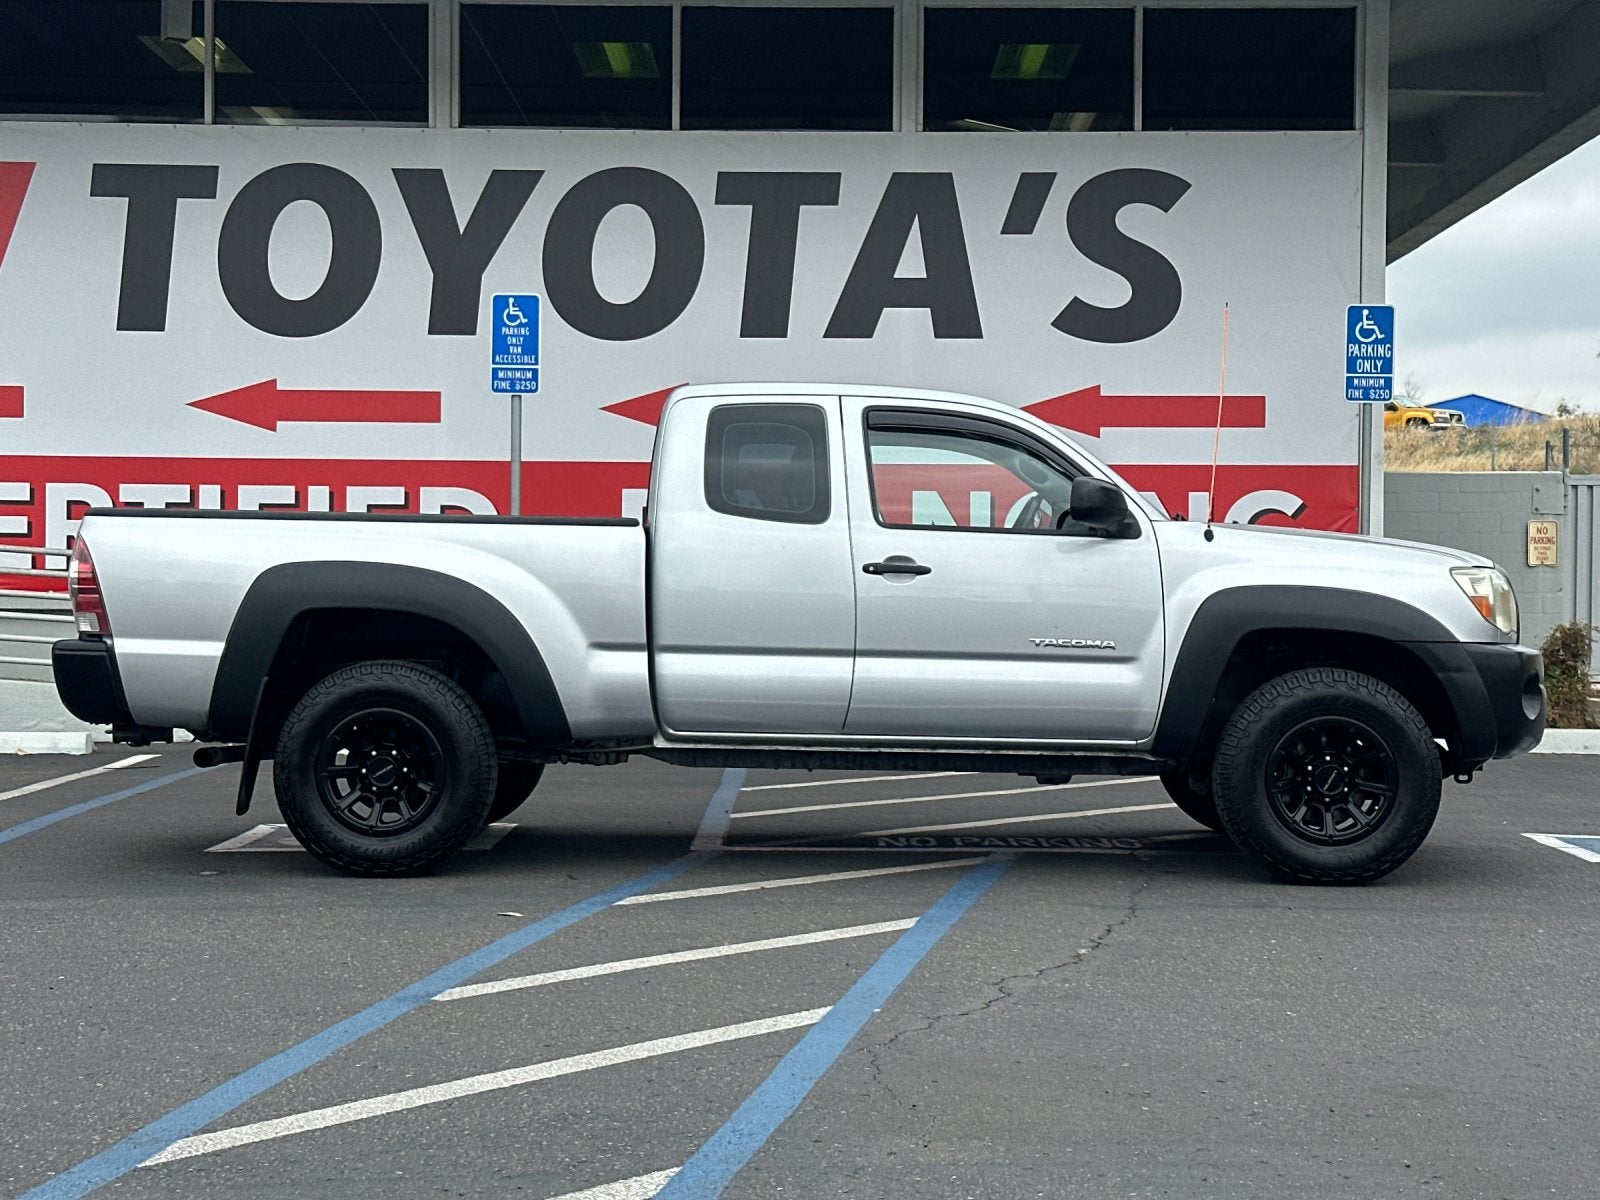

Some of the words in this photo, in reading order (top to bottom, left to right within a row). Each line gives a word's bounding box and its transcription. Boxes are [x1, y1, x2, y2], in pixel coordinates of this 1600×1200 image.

[89, 162, 1192, 343] TOYOTA'S
[501, 326, 530, 335] PARKING
[507, 336, 524, 345] ONLY
[509, 345, 522, 354] VAN
[1348, 343, 1392, 358] PARKING
[495, 354, 536, 364] ACCESSIBLE
[1356, 359, 1383, 373] ONLY
[498, 369, 533, 379] MINIMUM
[493, 380, 511, 390] FINE
[514, 381, 537, 391] $250
[1353, 377, 1385, 388] MINIMUM
[1348, 388, 1364, 399] FINE
[1369, 389, 1390, 400] $250
[1536, 526, 1549, 535] NO
[1530, 536, 1556, 545] PARKING
[1029, 637, 1117, 650] TACOMA
[876, 836, 938, 848] NO
[953, 835, 1144, 850] PARKING
